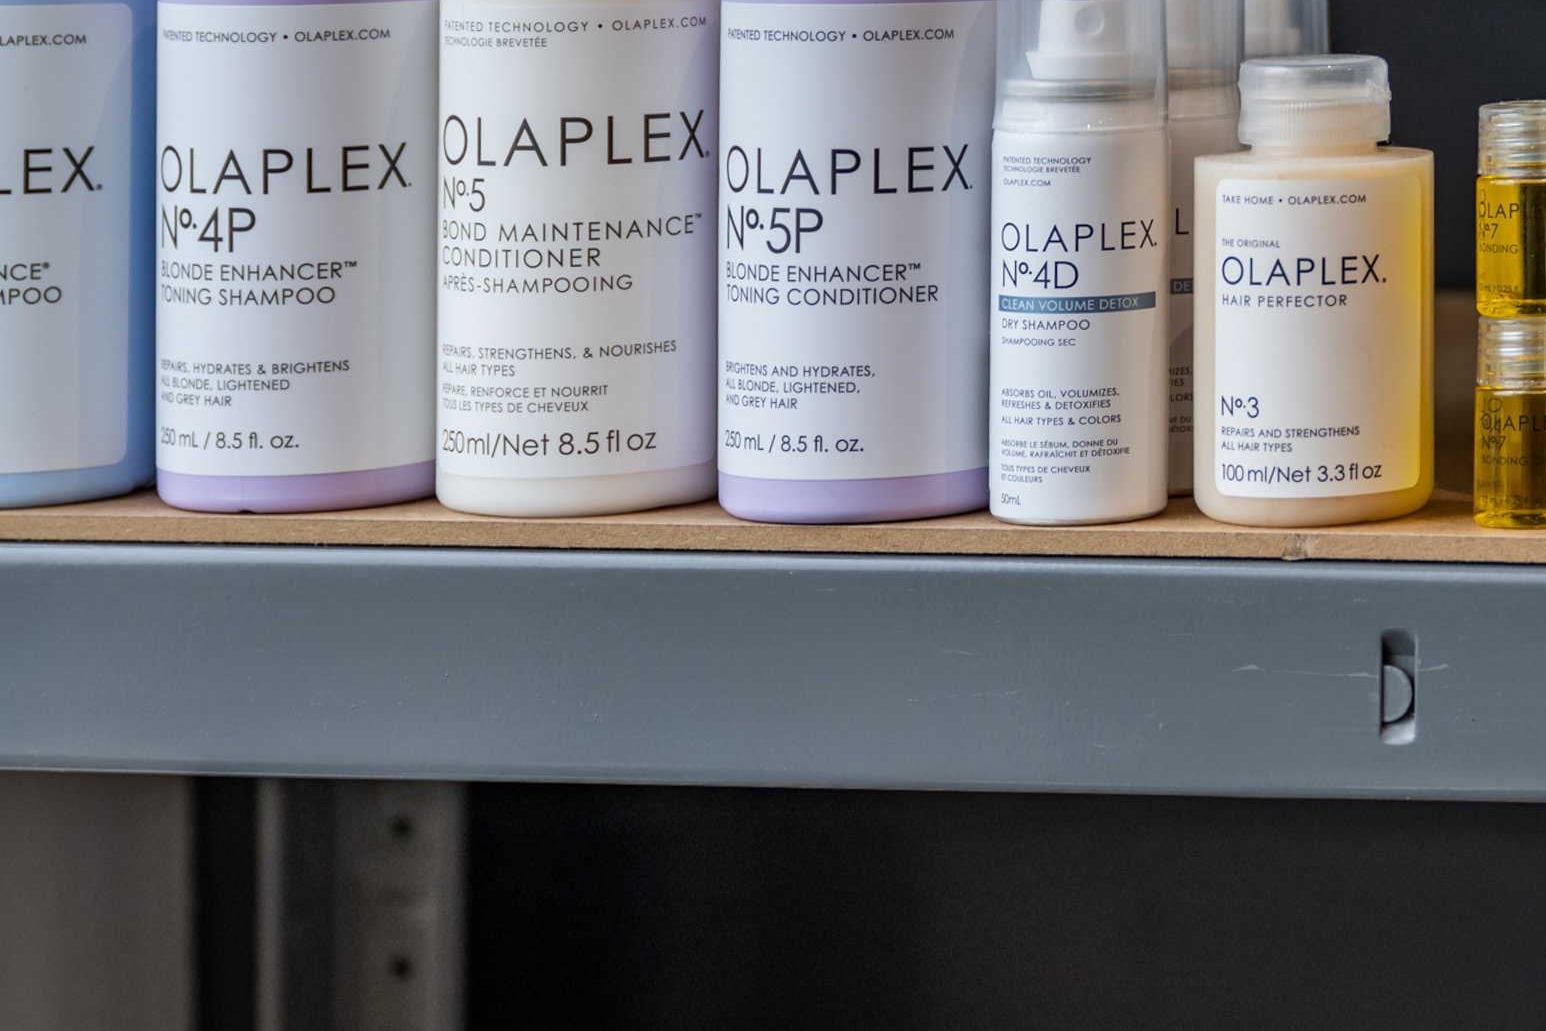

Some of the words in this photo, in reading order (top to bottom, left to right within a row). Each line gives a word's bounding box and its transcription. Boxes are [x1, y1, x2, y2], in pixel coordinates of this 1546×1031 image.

[445, 20, 483, 32] PATENTED
[489, 21, 588, 33] TECHNOLOGY
[612, 16, 706, 31] OLAPLEX.COM
[195, 31, 277, 43] TECHNOLOGY
[294, 29, 390, 42] OLAPLEX.COM
[764, 30, 846, 42] TECHNOLOGY
[863, 29, 954, 41] OLAPLEX.COM
[1222, 194, 1241, 204] TAKE
[1244, 196, 1273, 205] HOME
[1288, 194, 1366, 205] OLAPLEX.COM
[443, 220, 486, 241] BOND
[1222, 238, 1234, 247] THE
[1237, 239, 1280, 248] ORIGINAL
[444, 246, 600, 269] CONDITIONER
[162, 260, 213, 281] BLONDE
[727, 261, 779, 282] BLONDE
[443, 273, 632, 293] APRÈS-SHAMPOOING
[161, 284, 212, 305] TONING
[219, 286, 335, 306] SHAMPOO
[727, 284, 779, 305] TONING
[787, 285, 938, 306] CONDITIONER
[1222, 294, 1251, 306] HAIR
[1258, 294, 1347, 307] PERFECTOR
[1001, 298, 1034, 310] CLEAN
[1039, 299, 1094, 312] VOLUME
[1099, 297, 1138, 310] DETOX
[1002, 318, 1019, 329] DRY
[1023, 319, 1090, 330] SHAMPOO
[479, 347, 576, 360] STRENGTHENS,
[583, 347, 593, 359] &
[599, 340, 676, 357] NOURISHES
[193, 363, 252, 375] HYDRATES
[257, 364, 266, 375] &
[272, 360, 350, 375] BRIGHTENS
[726, 361, 768, 376] BRIGHTENS
[771, 366, 798, 377] AND
[803, 365, 875, 377] HYDRATES,
[1014, 417, 1033, 425] HAIR
[1036, 417, 1063, 426] TYPES
[1068, 417, 1075, 425] &
[1079, 414, 1121, 425] COLORS
[161, 427, 176, 446] 250
[179, 431, 199, 448] mL
[203, 431, 211, 450] /
[216, 432, 242, 449] 8.5
[248, 432, 263, 449] fl.
[270, 435, 299, 449] oz.
[1221, 426, 1255, 438] REPAIRS
[1258, 429, 1282, 438] AND
[1285, 426, 1360, 438] STRENGTHENS
[559, 432, 599, 455] 8.5
[627, 432, 656, 451] oz
[725, 430, 741, 449] 250
[744, 434, 764, 451] mL
[768, 434, 776, 453] /
[781, 435, 807, 452] 8.5
[814, 435, 828, 452] fl.
[836, 439, 863, 452] oz.
[1222, 464, 1244, 482] 100
[1317, 464, 1345, 482] 3.3
[1362, 465, 1382, 479] oz
